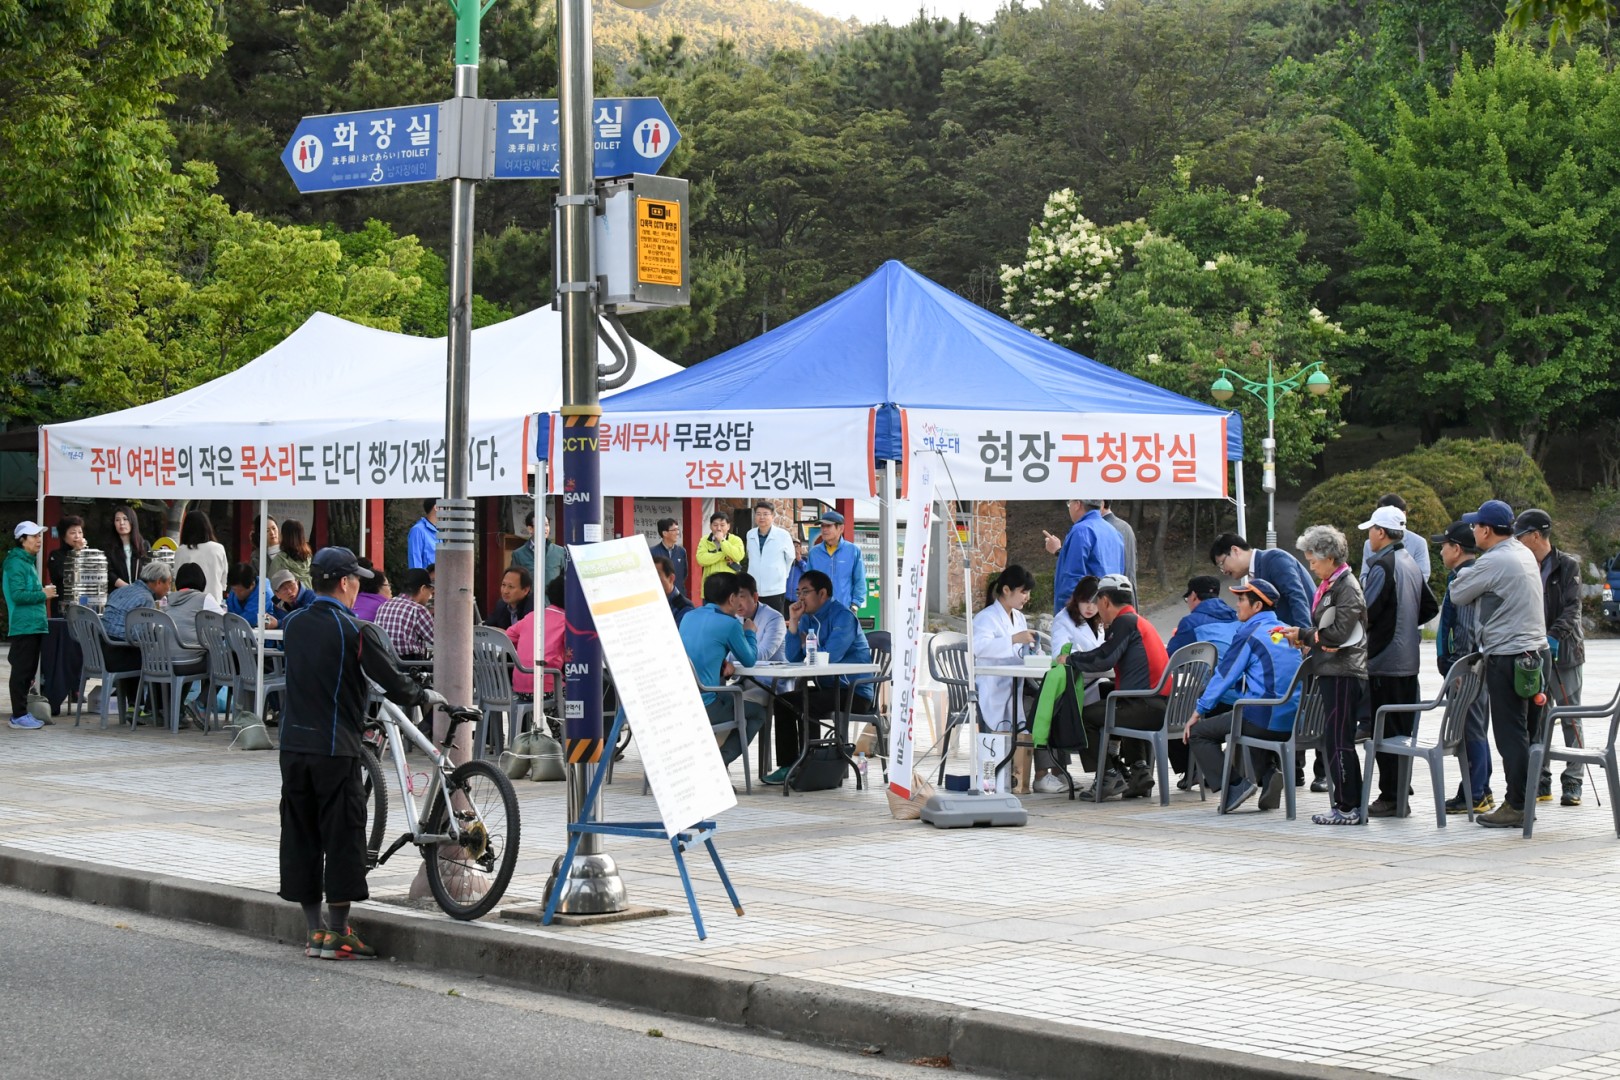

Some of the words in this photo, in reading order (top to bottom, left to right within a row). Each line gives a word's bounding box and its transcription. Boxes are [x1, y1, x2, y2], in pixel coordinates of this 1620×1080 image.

[508, 106, 622, 140] 화실
[401, 148, 429, 158] TOILET
[594, 141, 621, 150] OILET
[673, 422, 754, 452] 무료상담
[90, 446, 122, 486] 주민
[127, 446, 194, 486] 여러분의
[199, 444, 234, 486] 작은
[240, 442, 316, 486] 목소리도
[323, 441, 360, 486] 단디
[977, 430, 1197, 483] 현장구청장실
[685, 460, 746, 490] 간호사
[750, 461, 835, 491] 건강체크
